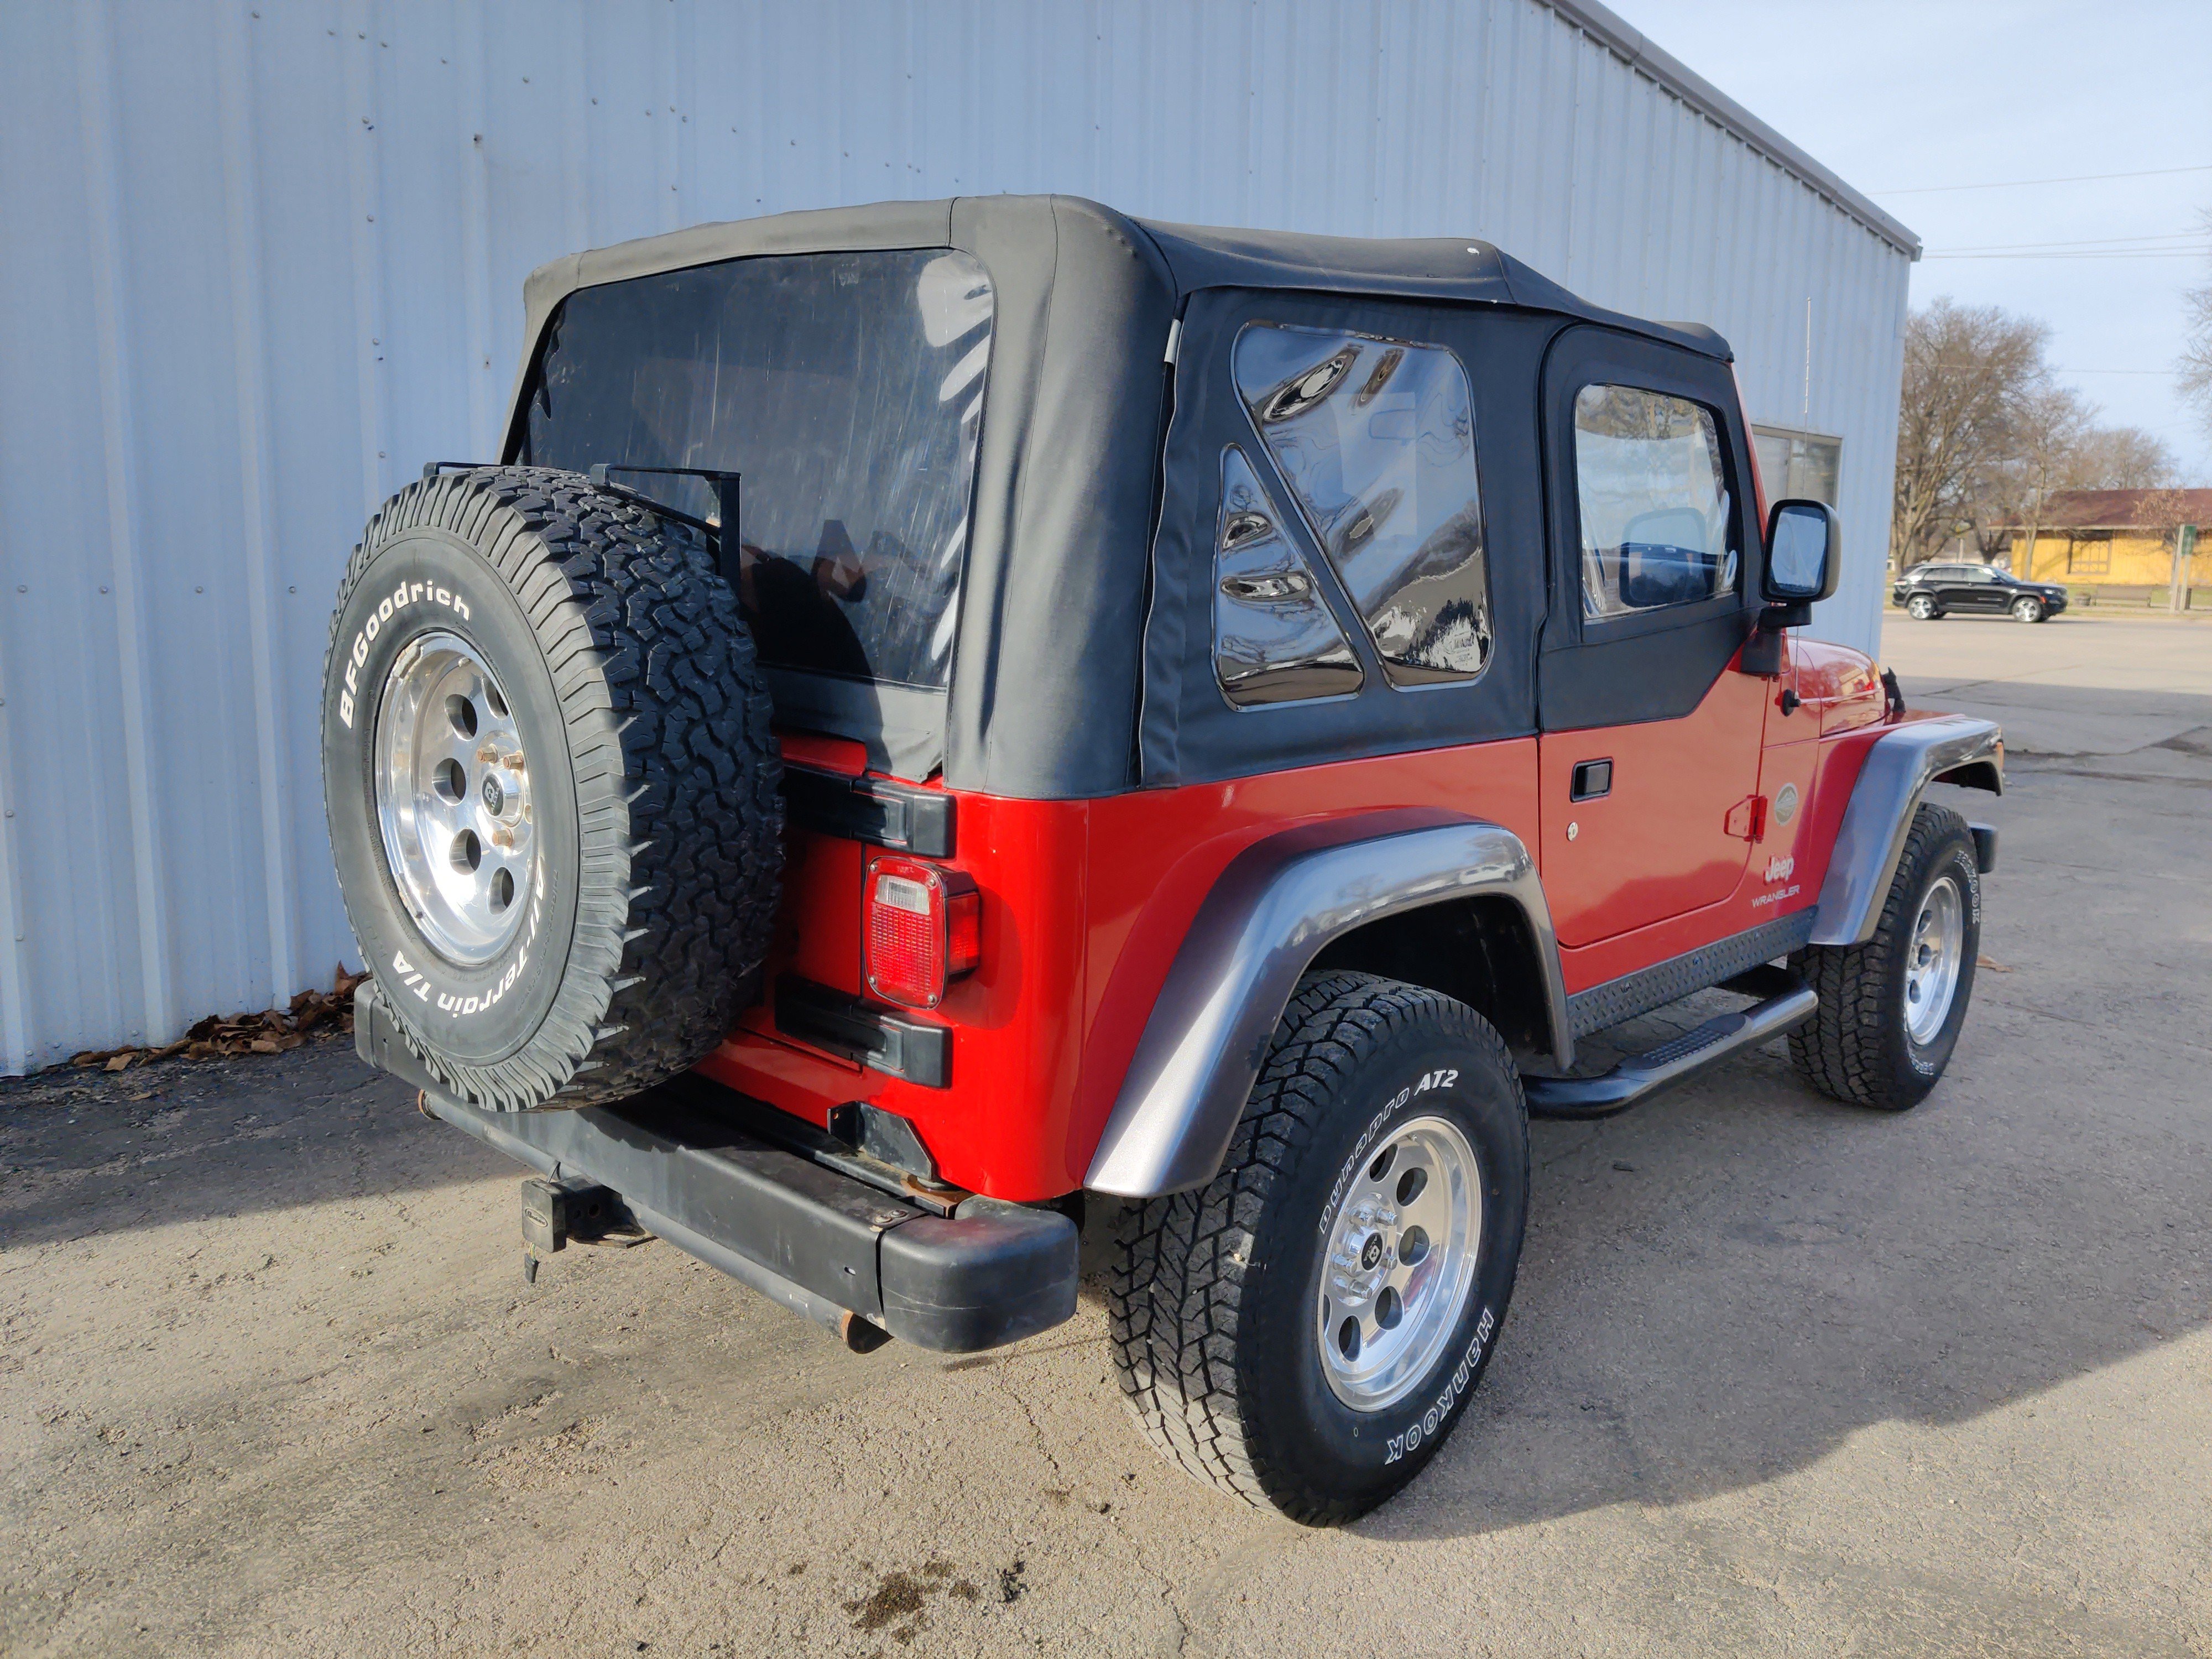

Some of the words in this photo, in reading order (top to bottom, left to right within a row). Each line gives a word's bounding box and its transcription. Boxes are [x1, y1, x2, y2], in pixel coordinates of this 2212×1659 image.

[340, 581, 469, 729] BFGoodrich
[1764, 855, 1794, 883] Jeep
[1752, 884, 1800, 907] WRANGLER
[393, 950, 431, 1002] T/A
[1319, 1088, 1410, 1234] Dynapro
[1414, 1070, 1458, 1096] AT2
